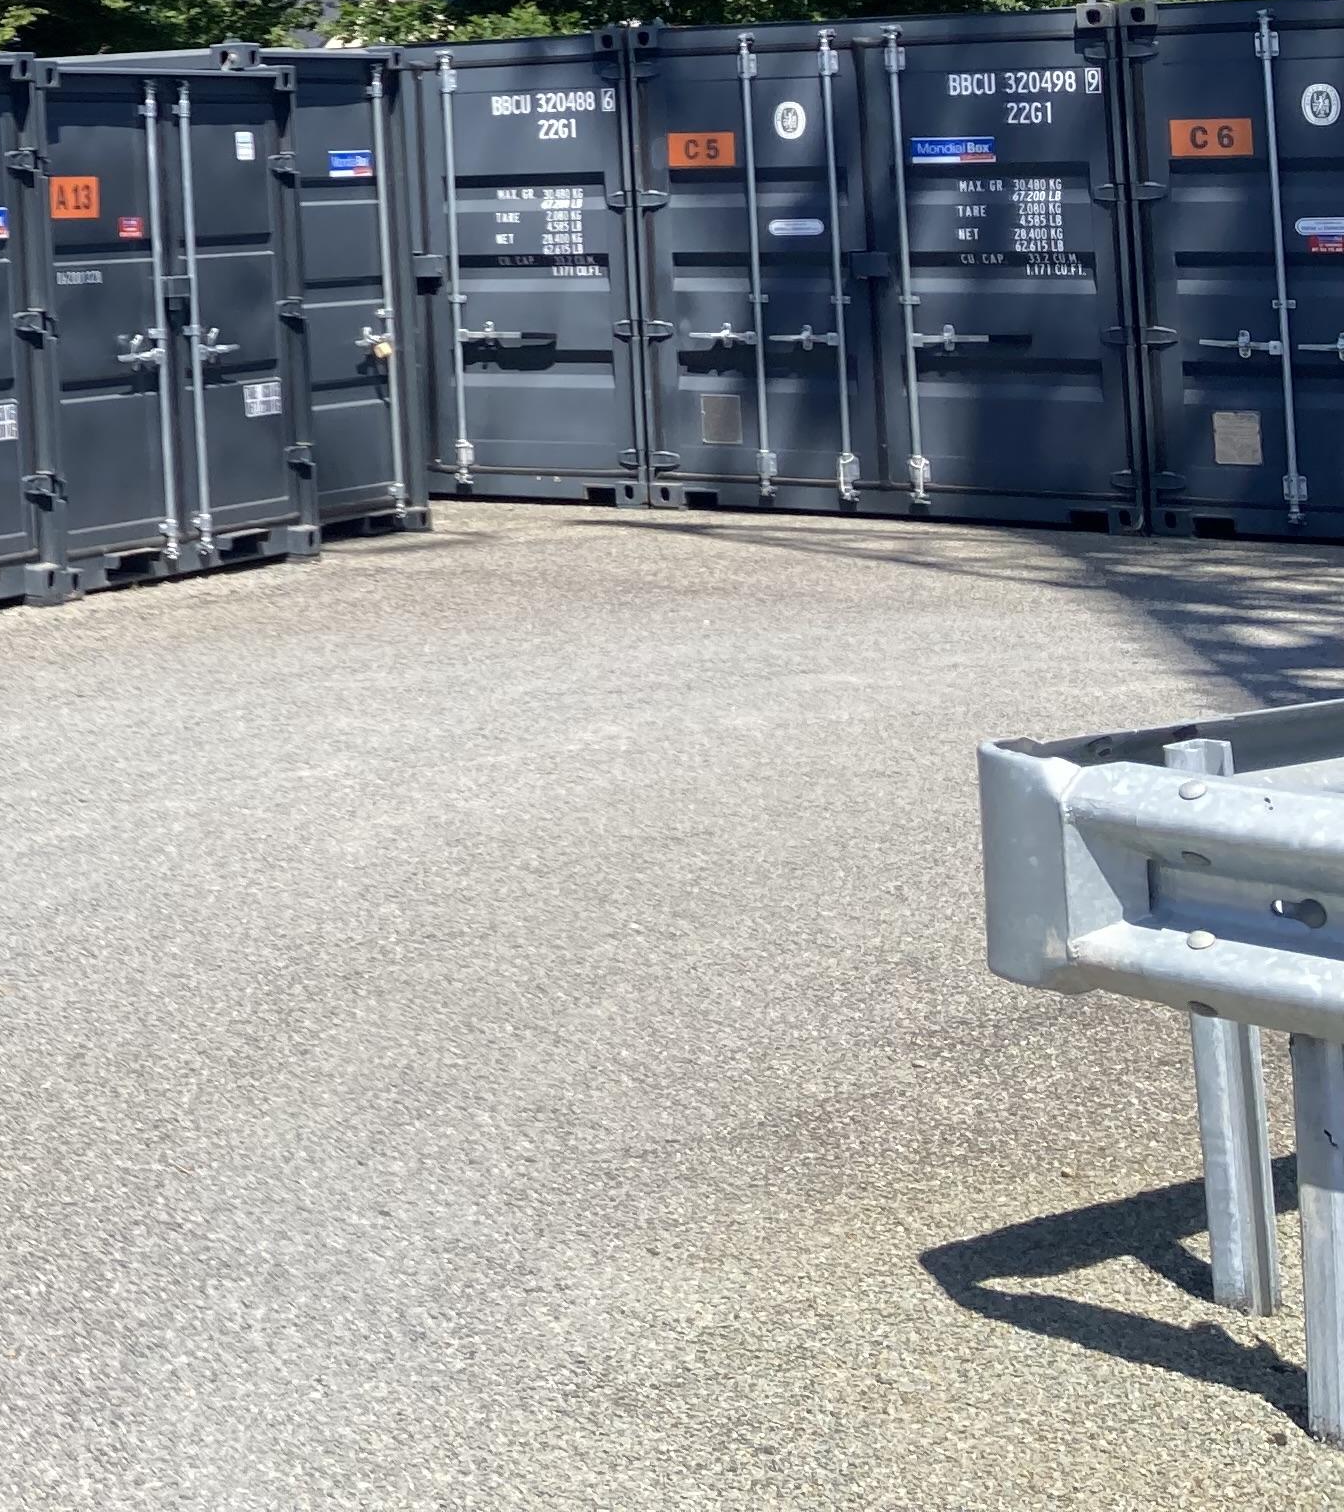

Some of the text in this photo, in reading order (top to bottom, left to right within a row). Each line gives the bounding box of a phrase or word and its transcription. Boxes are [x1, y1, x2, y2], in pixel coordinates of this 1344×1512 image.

[948, 73, 996, 96] BBCU
[1005, 71, 1077, 94] 320498
[491, 94, 531, 116] BBCU
[535, 91, 596, 113] 320488
[1006, 101, 1052, 124] 22G1
[1189, 125, 1234, 149] C 6
[685, 138, 720, 160] C 5
[1013, 178, 1046, 191] 30.480
[1049, 178, 1062, 190] KG
[56, 184, 90, 210] A 13
[1012, 191, 1062, 202] 67.200 LB
[958, 203, 1062, 217] TARE 2.080 KG
[1019, 215, 1062, 226] 4.585 LB
[958, 228, 979, 240] NET
[1050, 228, 1063, 239] KG
[1015, 240, 1064, 252] 62.615 LB
